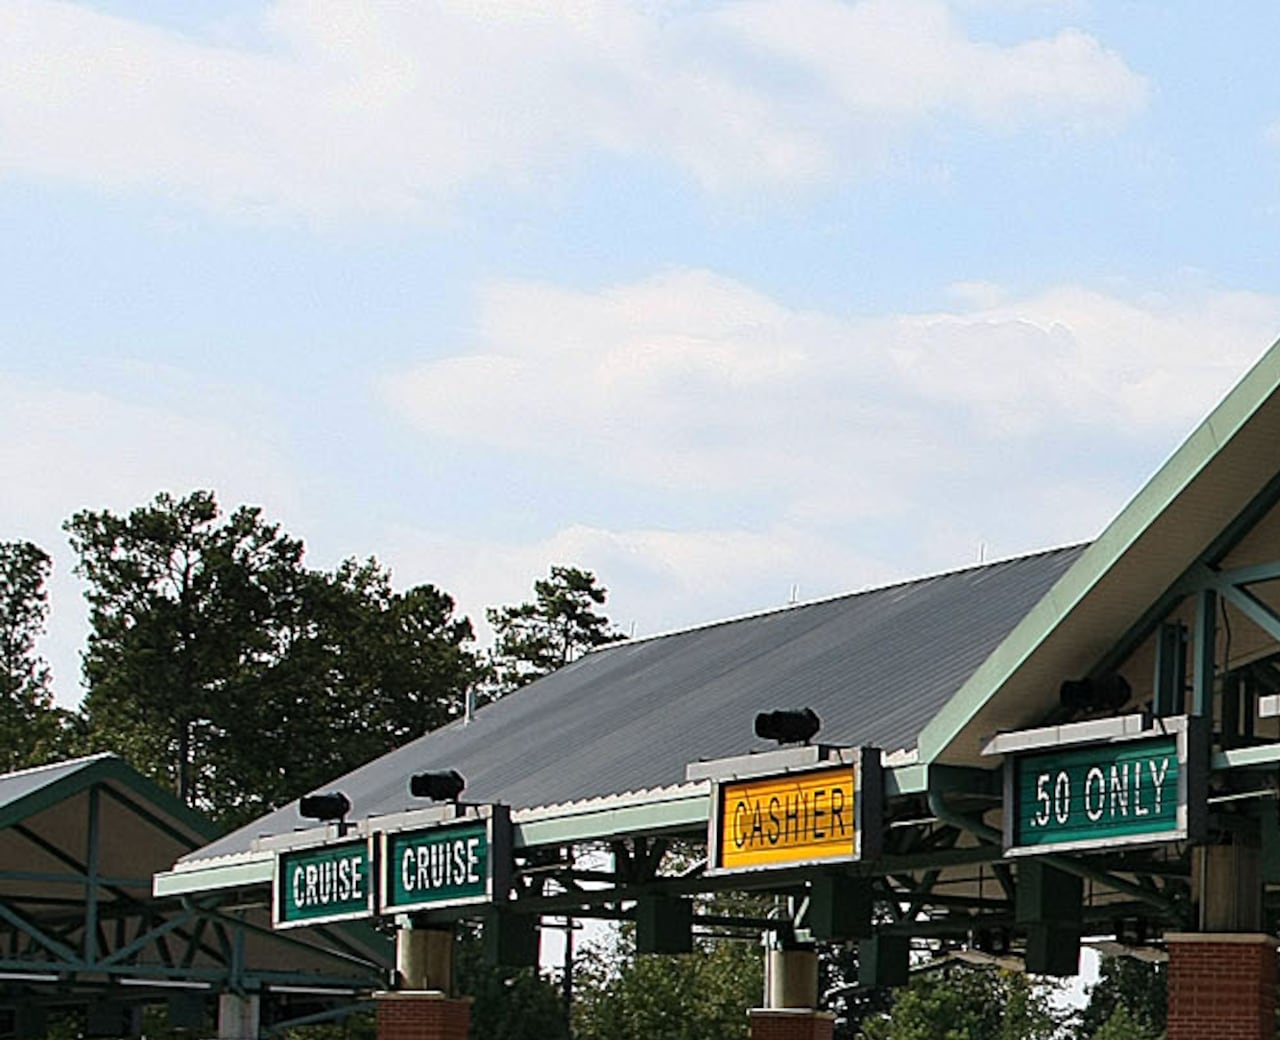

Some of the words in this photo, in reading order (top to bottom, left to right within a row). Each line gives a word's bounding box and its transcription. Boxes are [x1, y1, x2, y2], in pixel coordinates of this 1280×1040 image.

[733, 788, 845, 848] CASHIER
[1030, 772, 1070, 827] .50
[1085, 758, 1168, 820] ONLY
[292, 856, 362, 908] CRUISE
[402, 838, 479, 891] CRUISE
